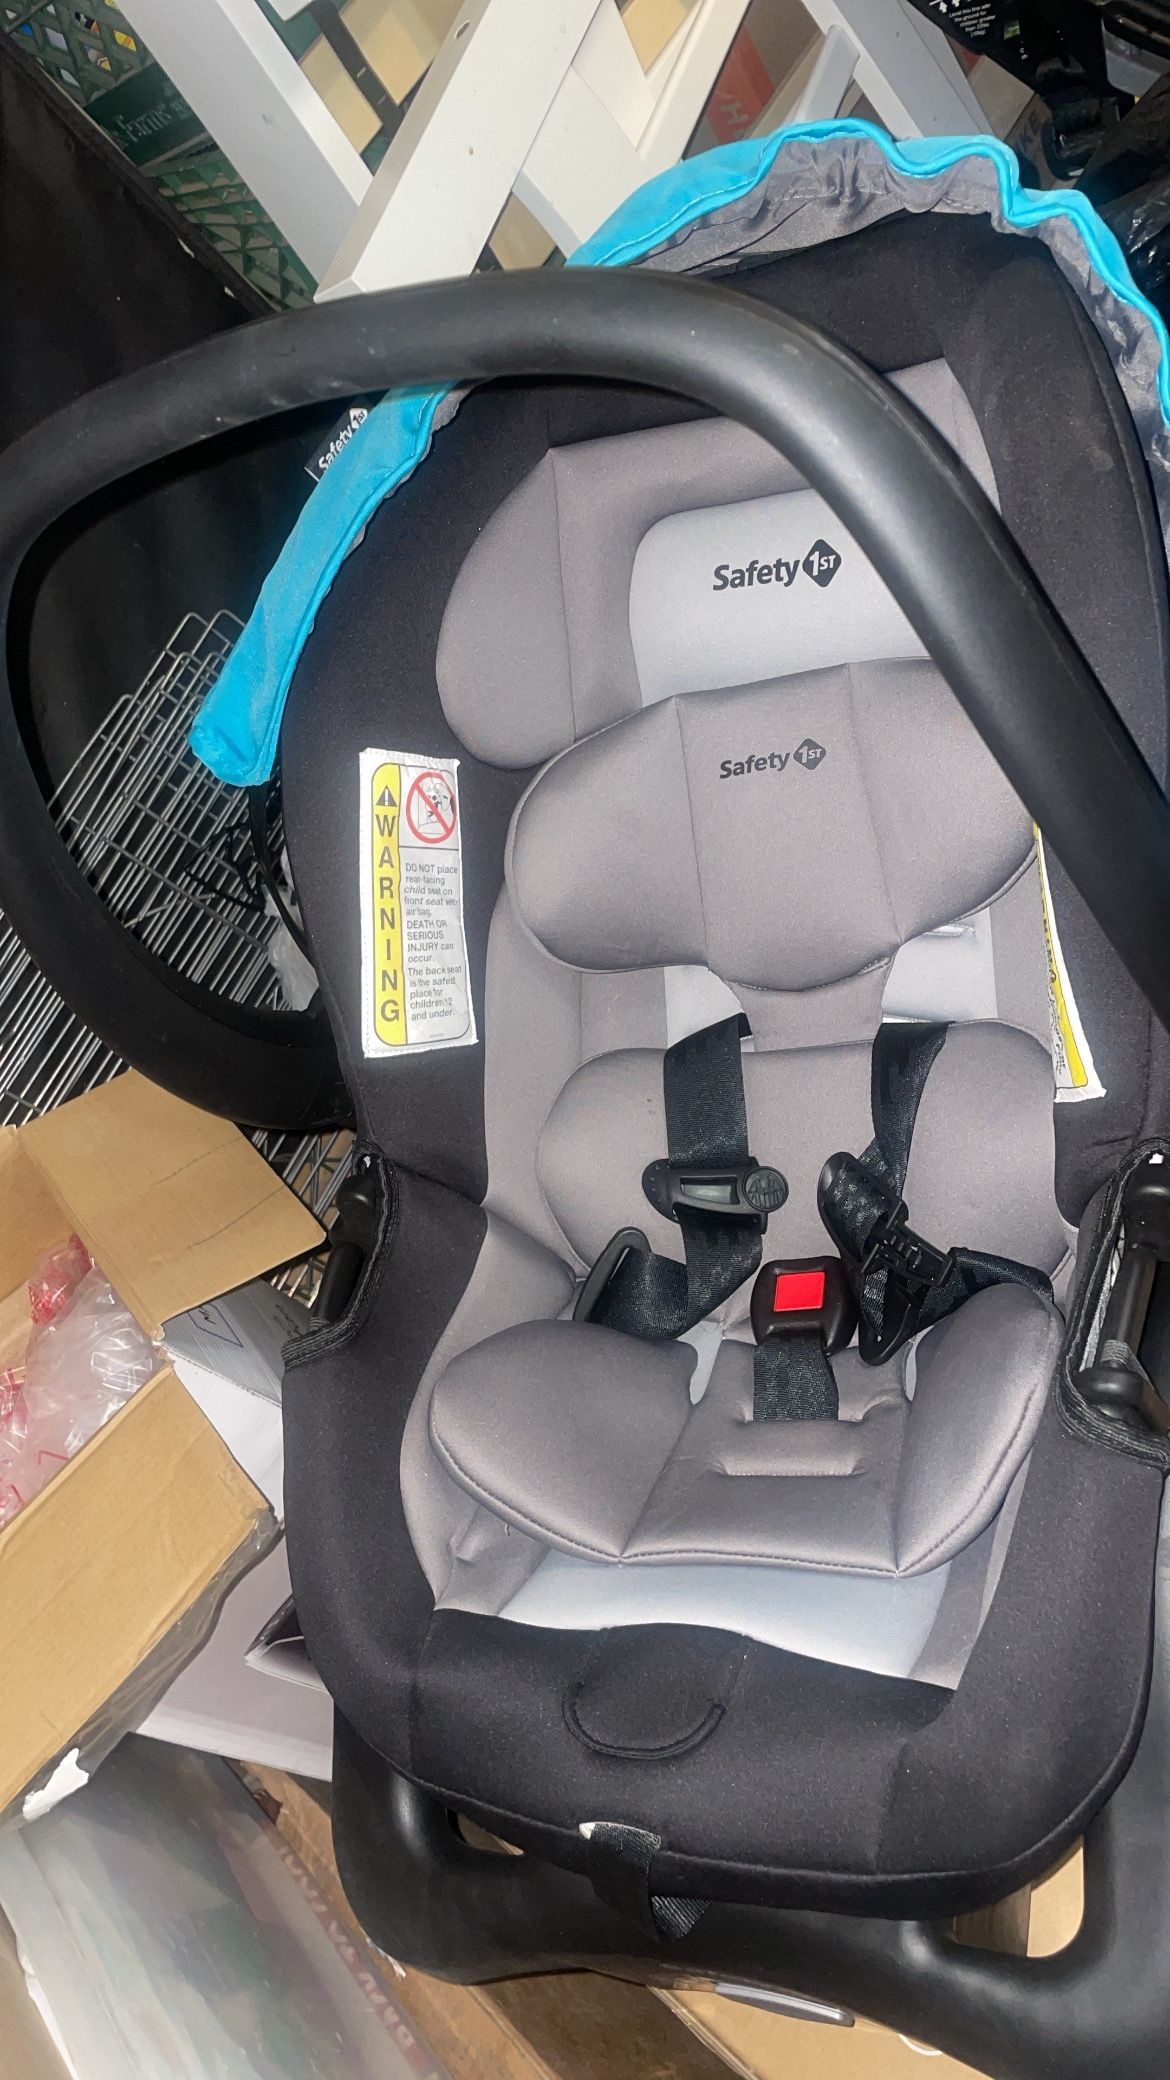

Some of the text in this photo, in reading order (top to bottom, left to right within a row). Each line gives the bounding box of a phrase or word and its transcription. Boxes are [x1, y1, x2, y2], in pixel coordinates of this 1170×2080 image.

[318, 424, 353, 470] Safety
[712, 558, 801, 591] Safety
[719, 751, 791, 779] Safety
[405, 863, 458, 875] DO NOT place
[405, 875, 446, 887] rear-facing
[403, 886, 426, 895] child
[442, 888, 453, 896] on
[425, 897, 443, 906] seat
[375, 813, 401, 1023] WARNING
[406, 919, 448, 929] DEATH OR
[406, 930, 444, 941] SERIOUS
[407, 941, 439, 952] INJURY
[407, 954, 436, 963] occur.
[408, 965, 462, 976] The back seat
[410, 980, 417, 988] is
[418, 978, 430, 987] the
[410, 988, 444, 1000] place for
[410, 998, 445, 1009] children
[411, 1008, 456, 1021] and under.
